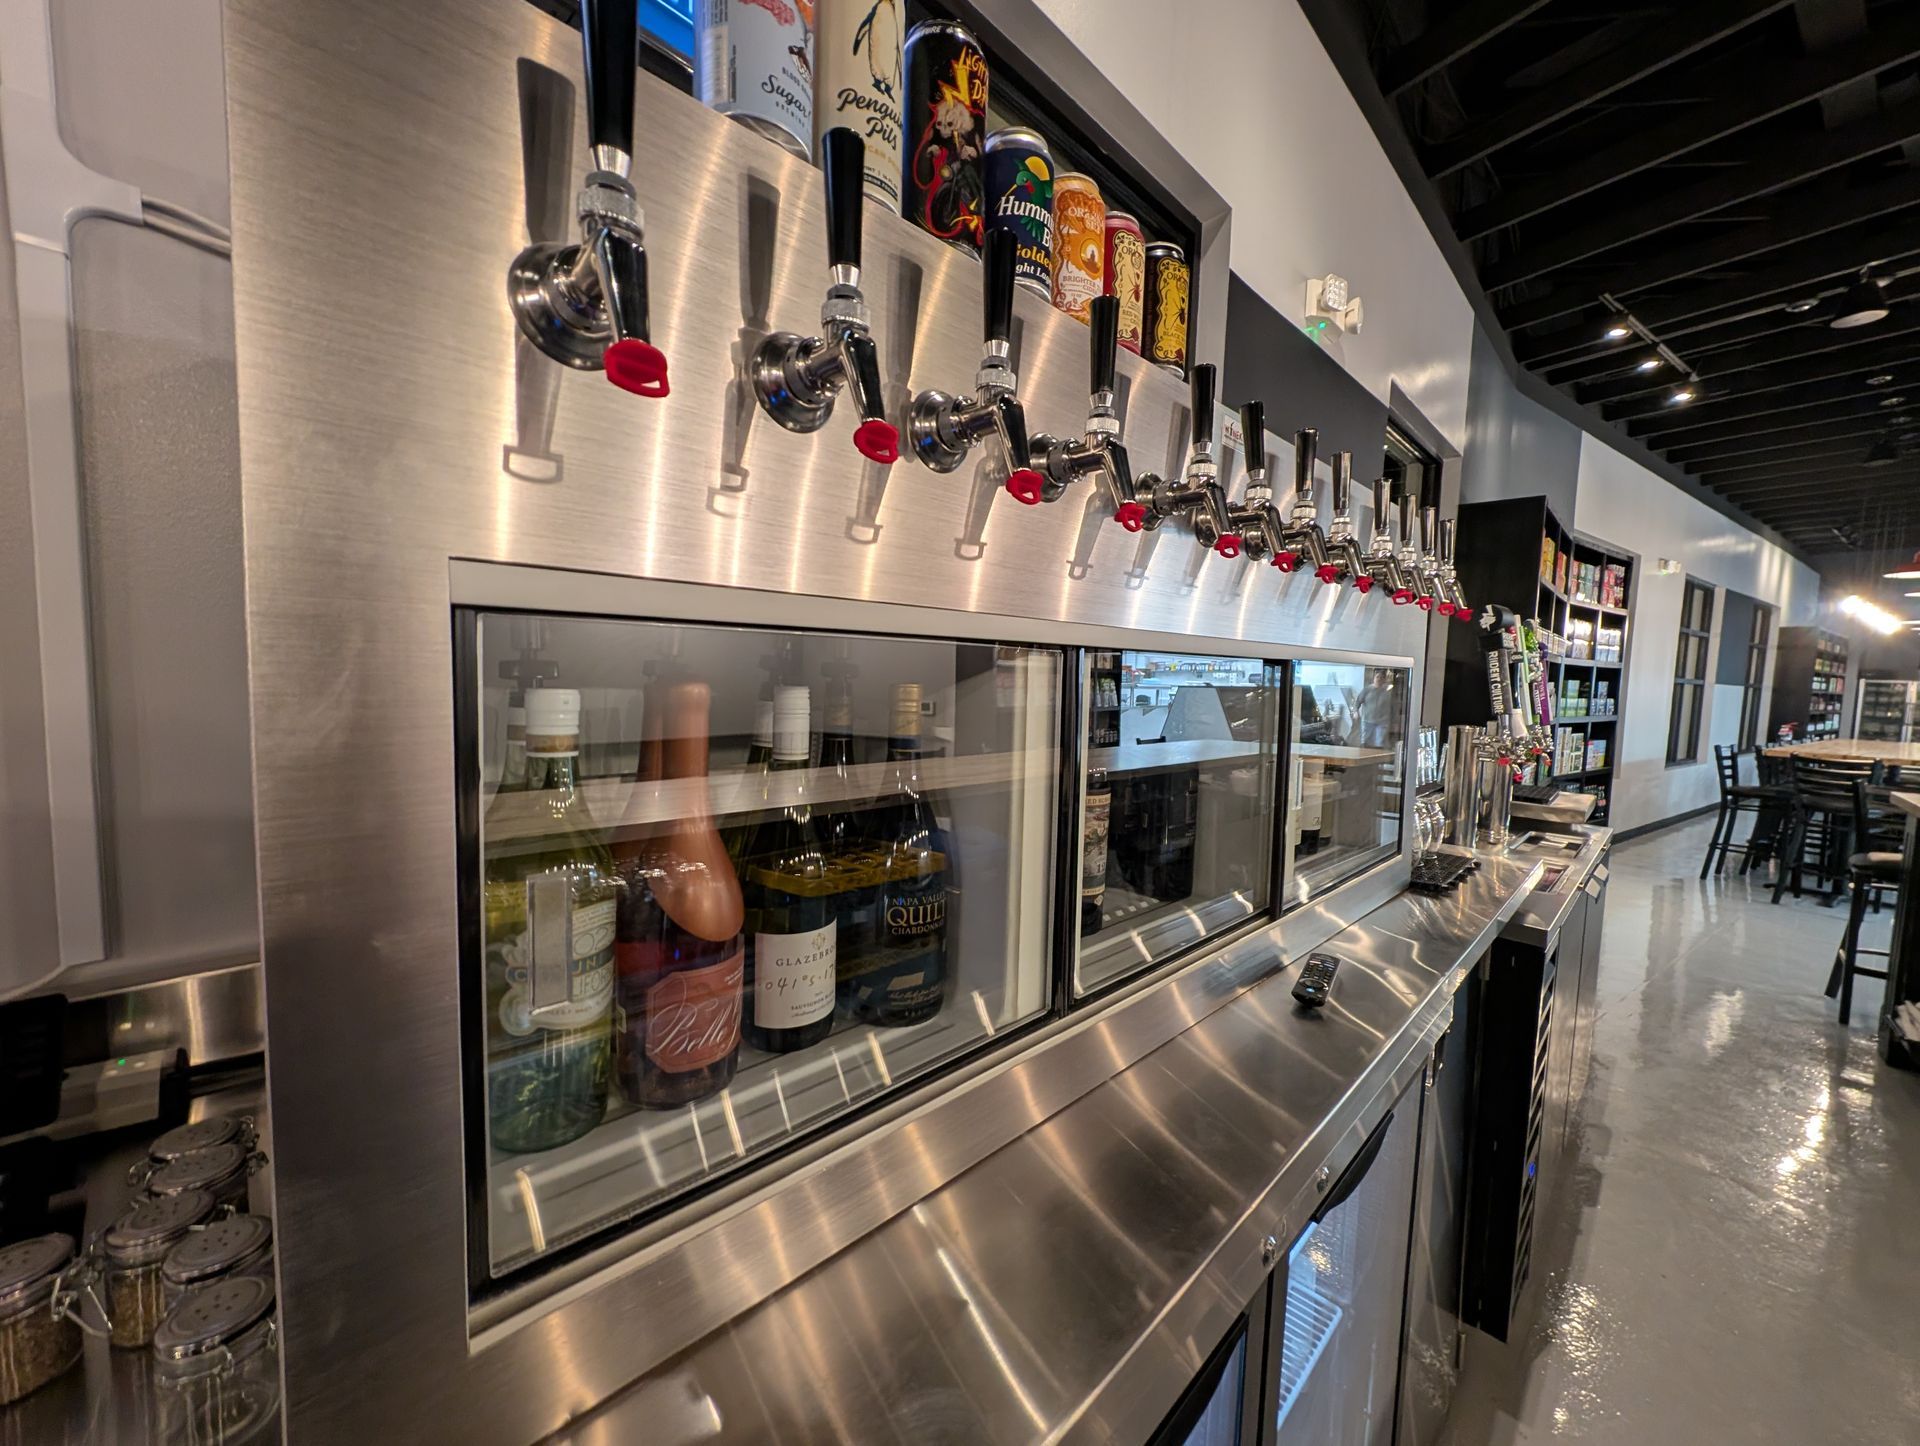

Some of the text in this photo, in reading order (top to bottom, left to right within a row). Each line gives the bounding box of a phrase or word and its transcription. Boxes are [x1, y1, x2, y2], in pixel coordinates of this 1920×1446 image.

[761, 74, 808, 118] Sugar
[865, 116, 896, 151] Pils
[1016, 244, 1052, 271] olde
[1016, 262, 1034, 275] ght
[893, 897, 919, 906] NAPA
